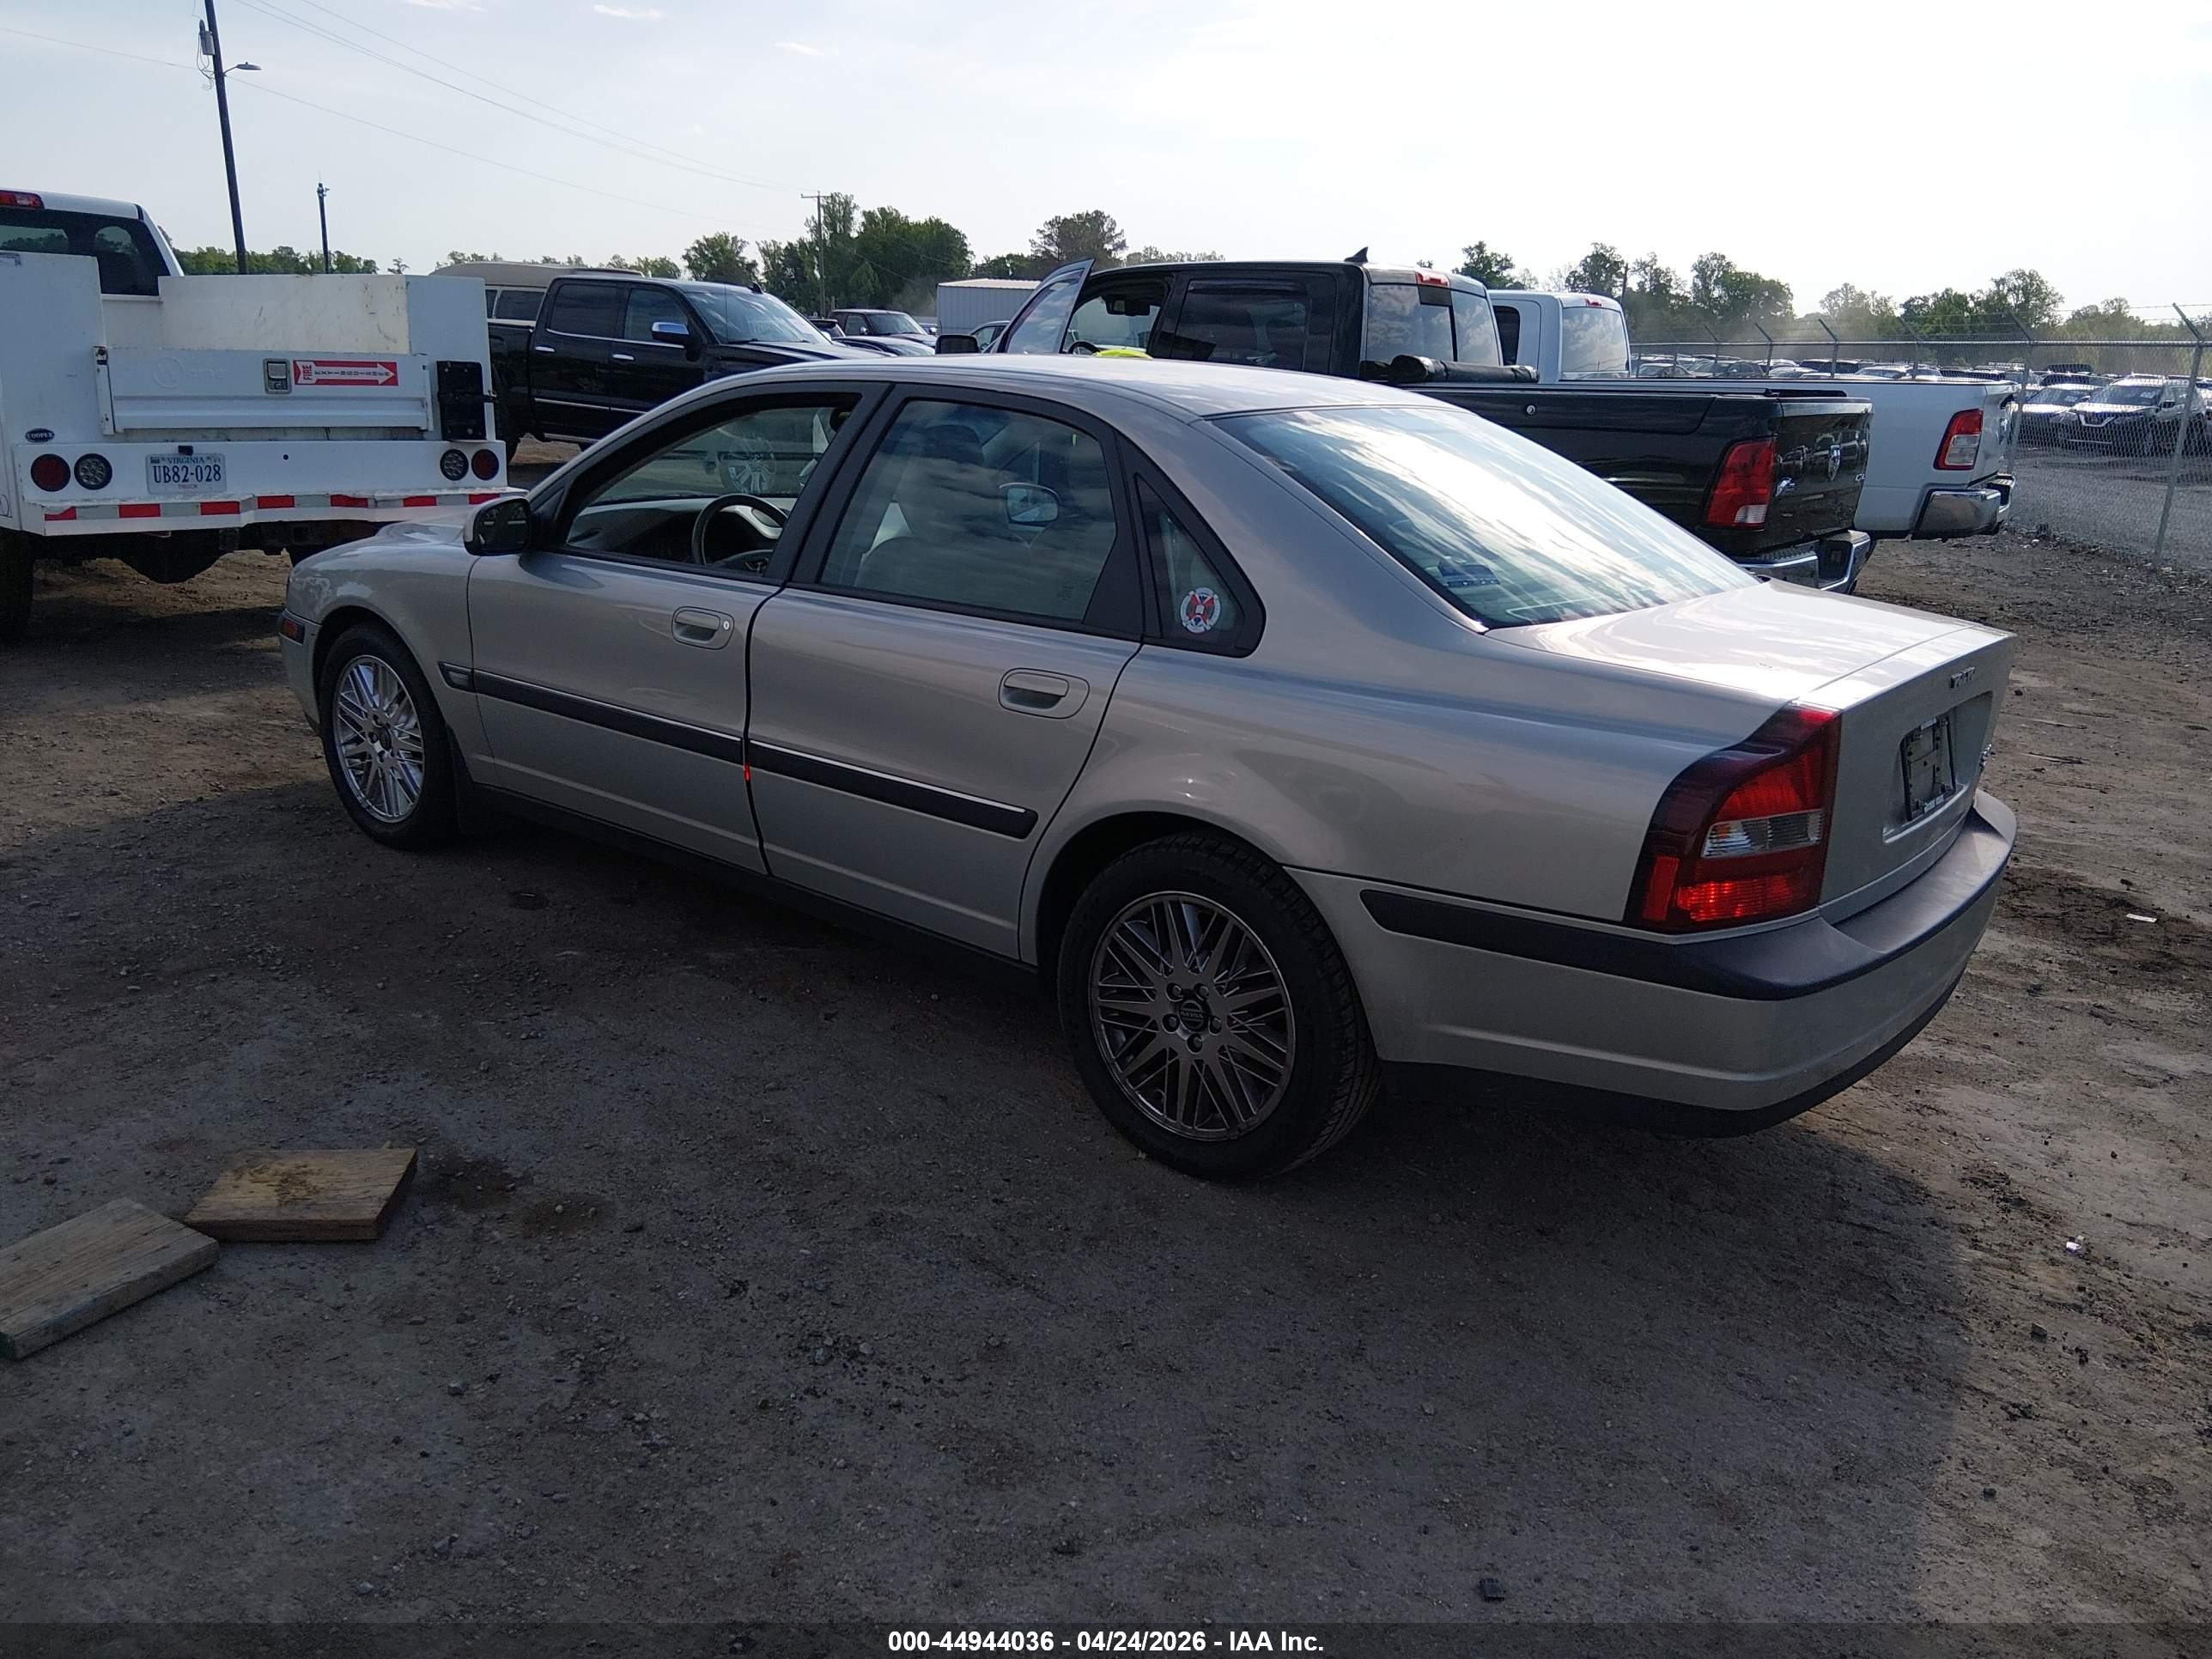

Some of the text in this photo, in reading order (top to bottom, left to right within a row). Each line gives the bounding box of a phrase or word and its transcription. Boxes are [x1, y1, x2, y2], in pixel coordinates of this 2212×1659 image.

[302, 364, 313, 380] FIRE
[167, 456, 205, 465] VIRGINIA
[153, 464, 222, 483] UB82-028
